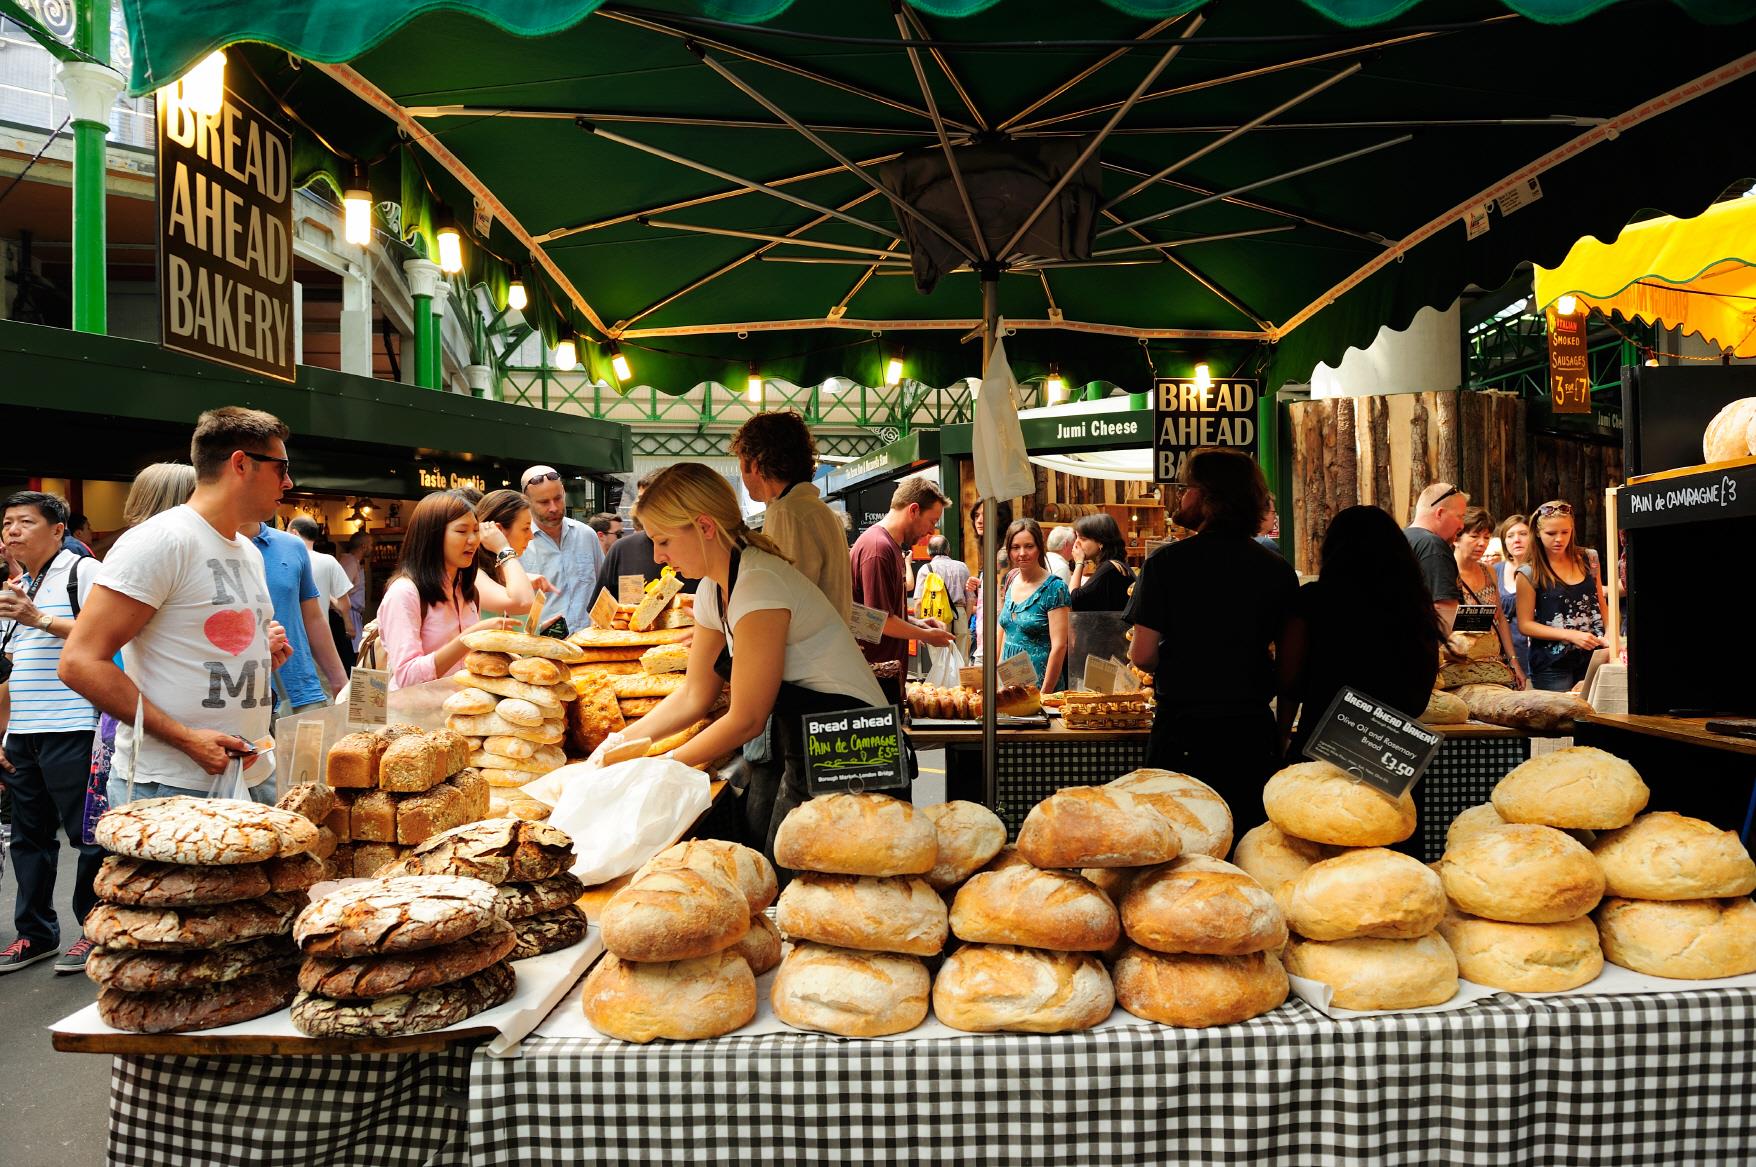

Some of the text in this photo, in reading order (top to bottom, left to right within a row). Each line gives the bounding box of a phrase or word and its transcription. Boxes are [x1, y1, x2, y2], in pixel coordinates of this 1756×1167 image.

[167, 82, 287, 204] BREAD
[169, 161, 288, 285] AHEAD
[169, 253, 289, 367] BAKERY
[1556, 317, 1578, 331] ITALIAN
[1552, 333, 1580, 346] SMOKED
[1552, 352, 1586, 369] SAUSAGES
[1158, 383, 1254, 412] BREAD
[1555, 375, 1565, 406] 3
[1057, 420, 1138, 439] Jumi Cheese
[1159, 417, 1255, 446] AHEAD
[419, 469, 447, 489] Taste
[1631, 475, 1737, 514] PAIN de CAMPAGNE £3
[809, 713, 893, 734] Bread ahead
[1337, 713, 1417, 760] Olive Oil and Rosemary
[809, 734, 897, 756] PAIN de CAMPAGNE
[1361, 735, 1384, 751] Bread
[1380, 751, 1415, 777] £3.50
